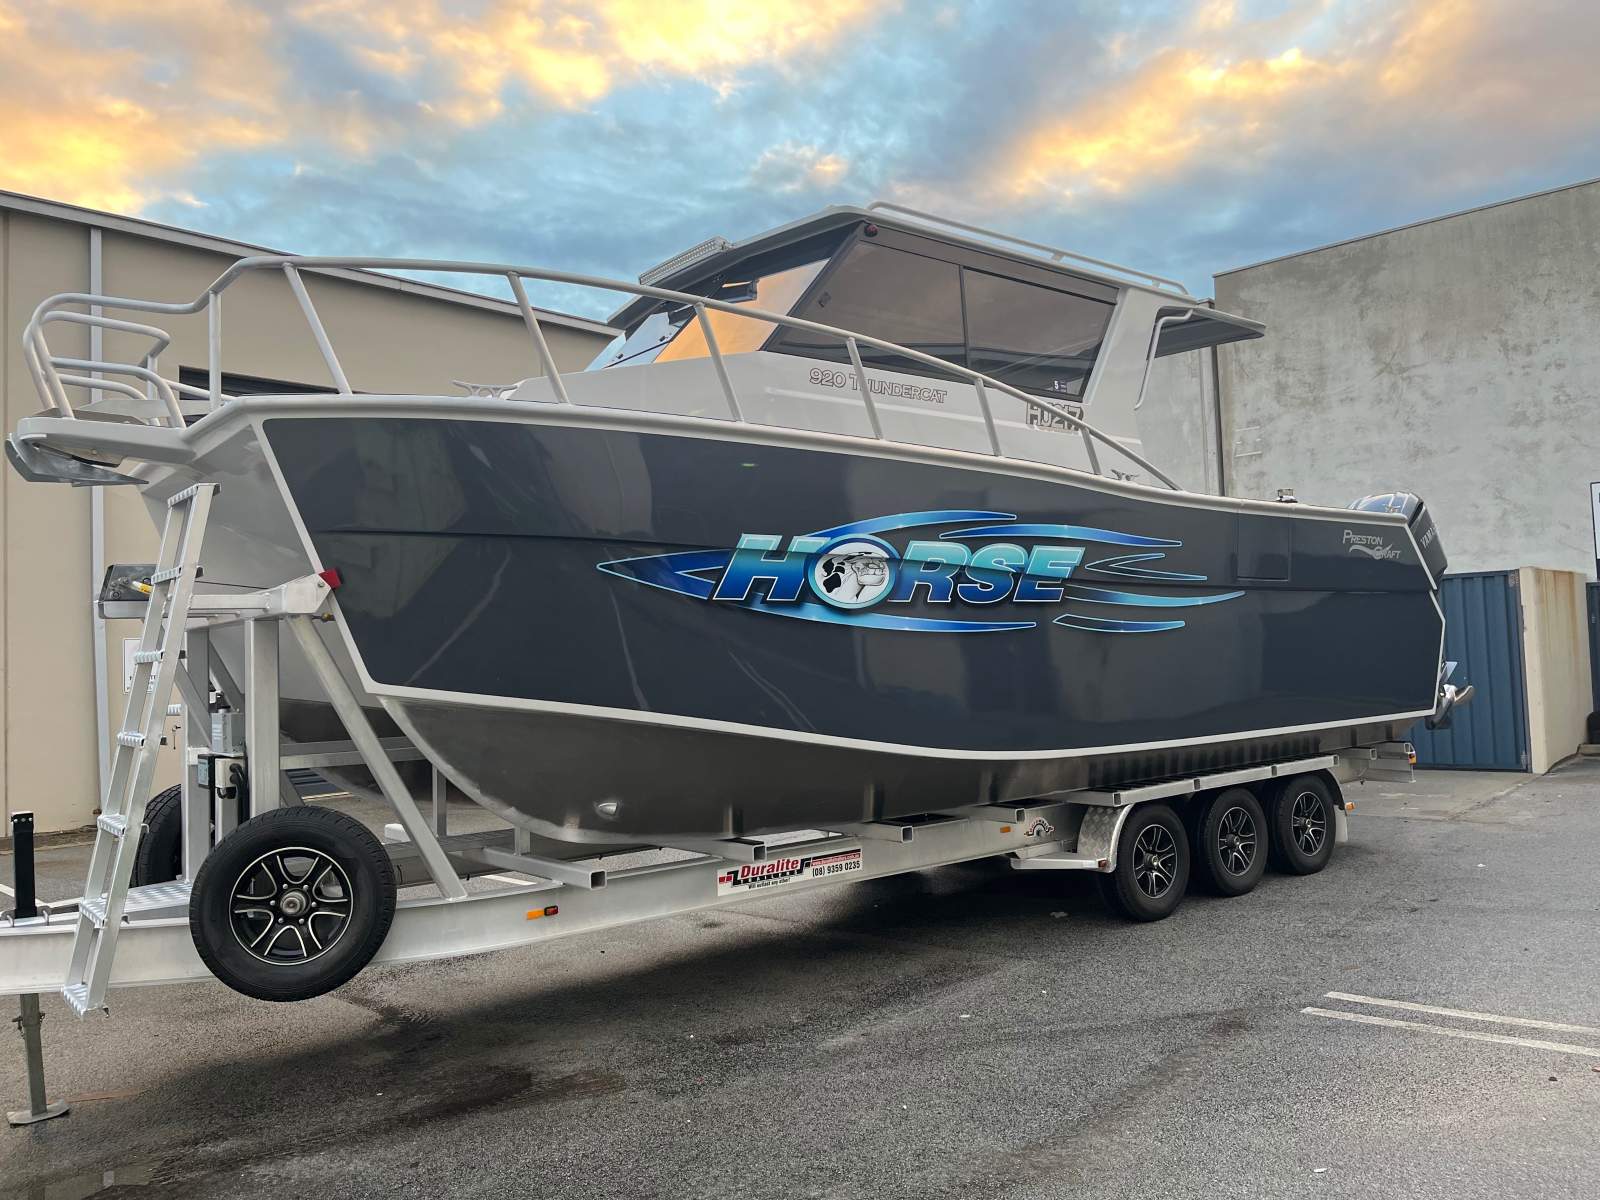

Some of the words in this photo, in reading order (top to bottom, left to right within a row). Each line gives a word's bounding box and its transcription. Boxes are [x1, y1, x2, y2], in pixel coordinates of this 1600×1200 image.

[809, 367, 846, 389] 920
[849, 373, 948, 404] TUNDERCAT
[1343, 529, 1384, 544] PRESTON
[713, 533, 1086, 609] HORSE
[740, 858, 800, 879] Duralite
[812, 865, 826, 877] (08)
[827, 863, 843, 874] 9359
[844, 860, 861, 871] 0235
